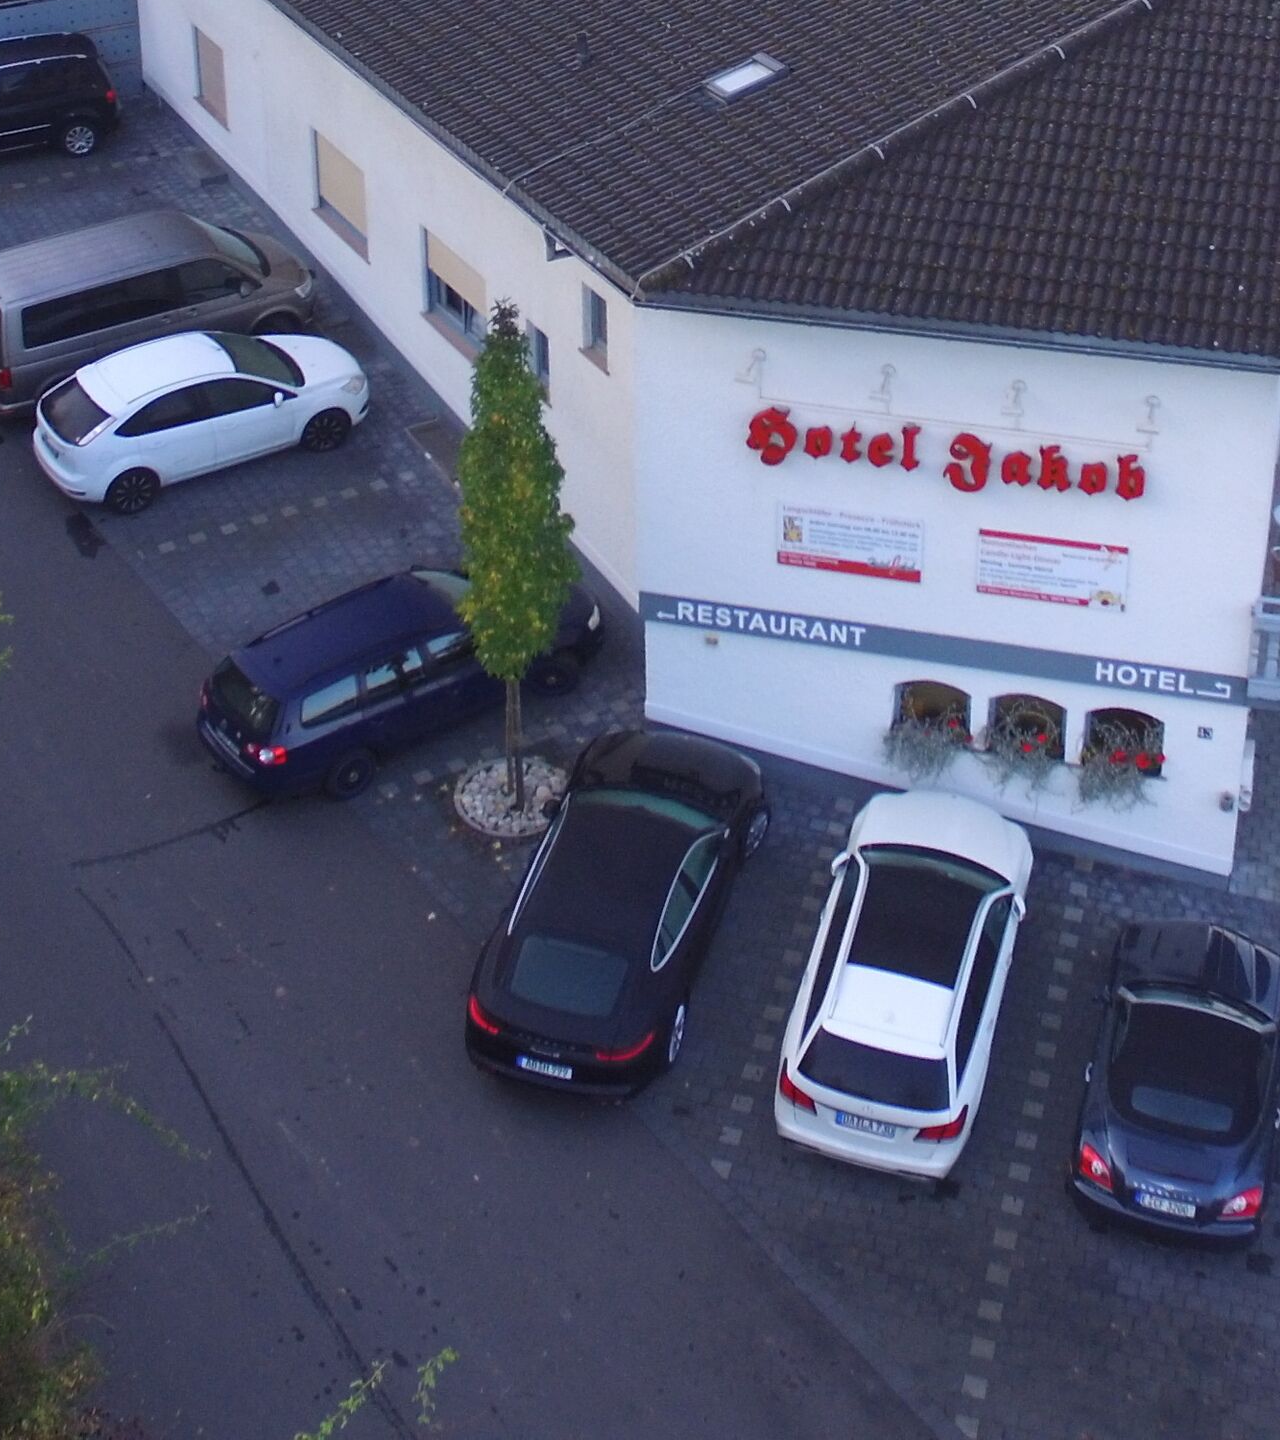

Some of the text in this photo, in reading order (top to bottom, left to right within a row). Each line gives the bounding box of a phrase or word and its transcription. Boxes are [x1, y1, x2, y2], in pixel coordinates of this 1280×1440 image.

[746, 406, 1146, 501] Hotel Jakob
[677, 601, 867, 647] RESTAURANT
[1095, 661, 1195, 694] HOTEL
